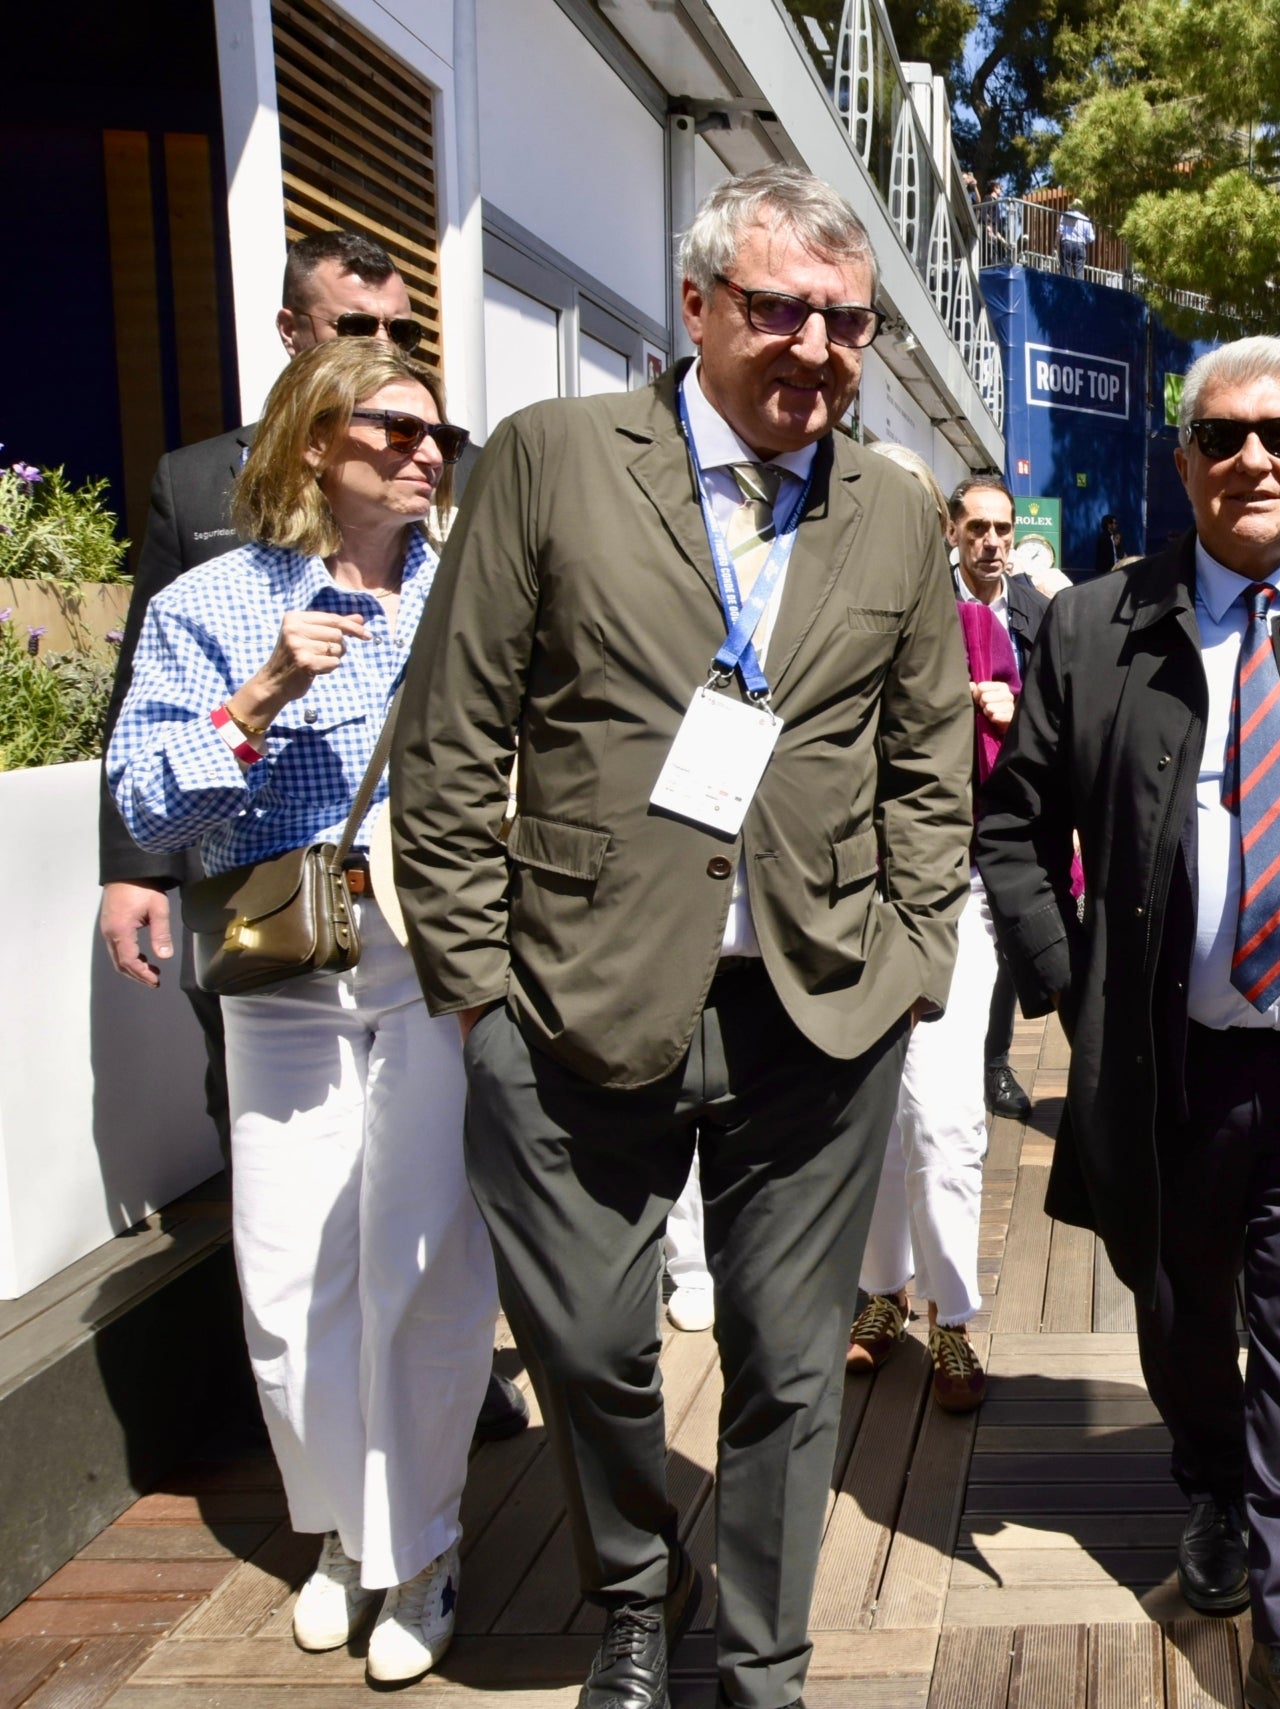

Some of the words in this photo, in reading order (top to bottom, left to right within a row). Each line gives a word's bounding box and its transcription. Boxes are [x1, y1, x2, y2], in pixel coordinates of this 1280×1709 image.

[1036, 360, 1084, 396] ROOF
[1087, 370, 1120, 402] TOP
[1015, 516, 1052, 526] ROLEX
[193, 528, 236, 540] Seguridad
[720, 567, 734, 593] CONDE
[726, 595, 737, 605] DE
